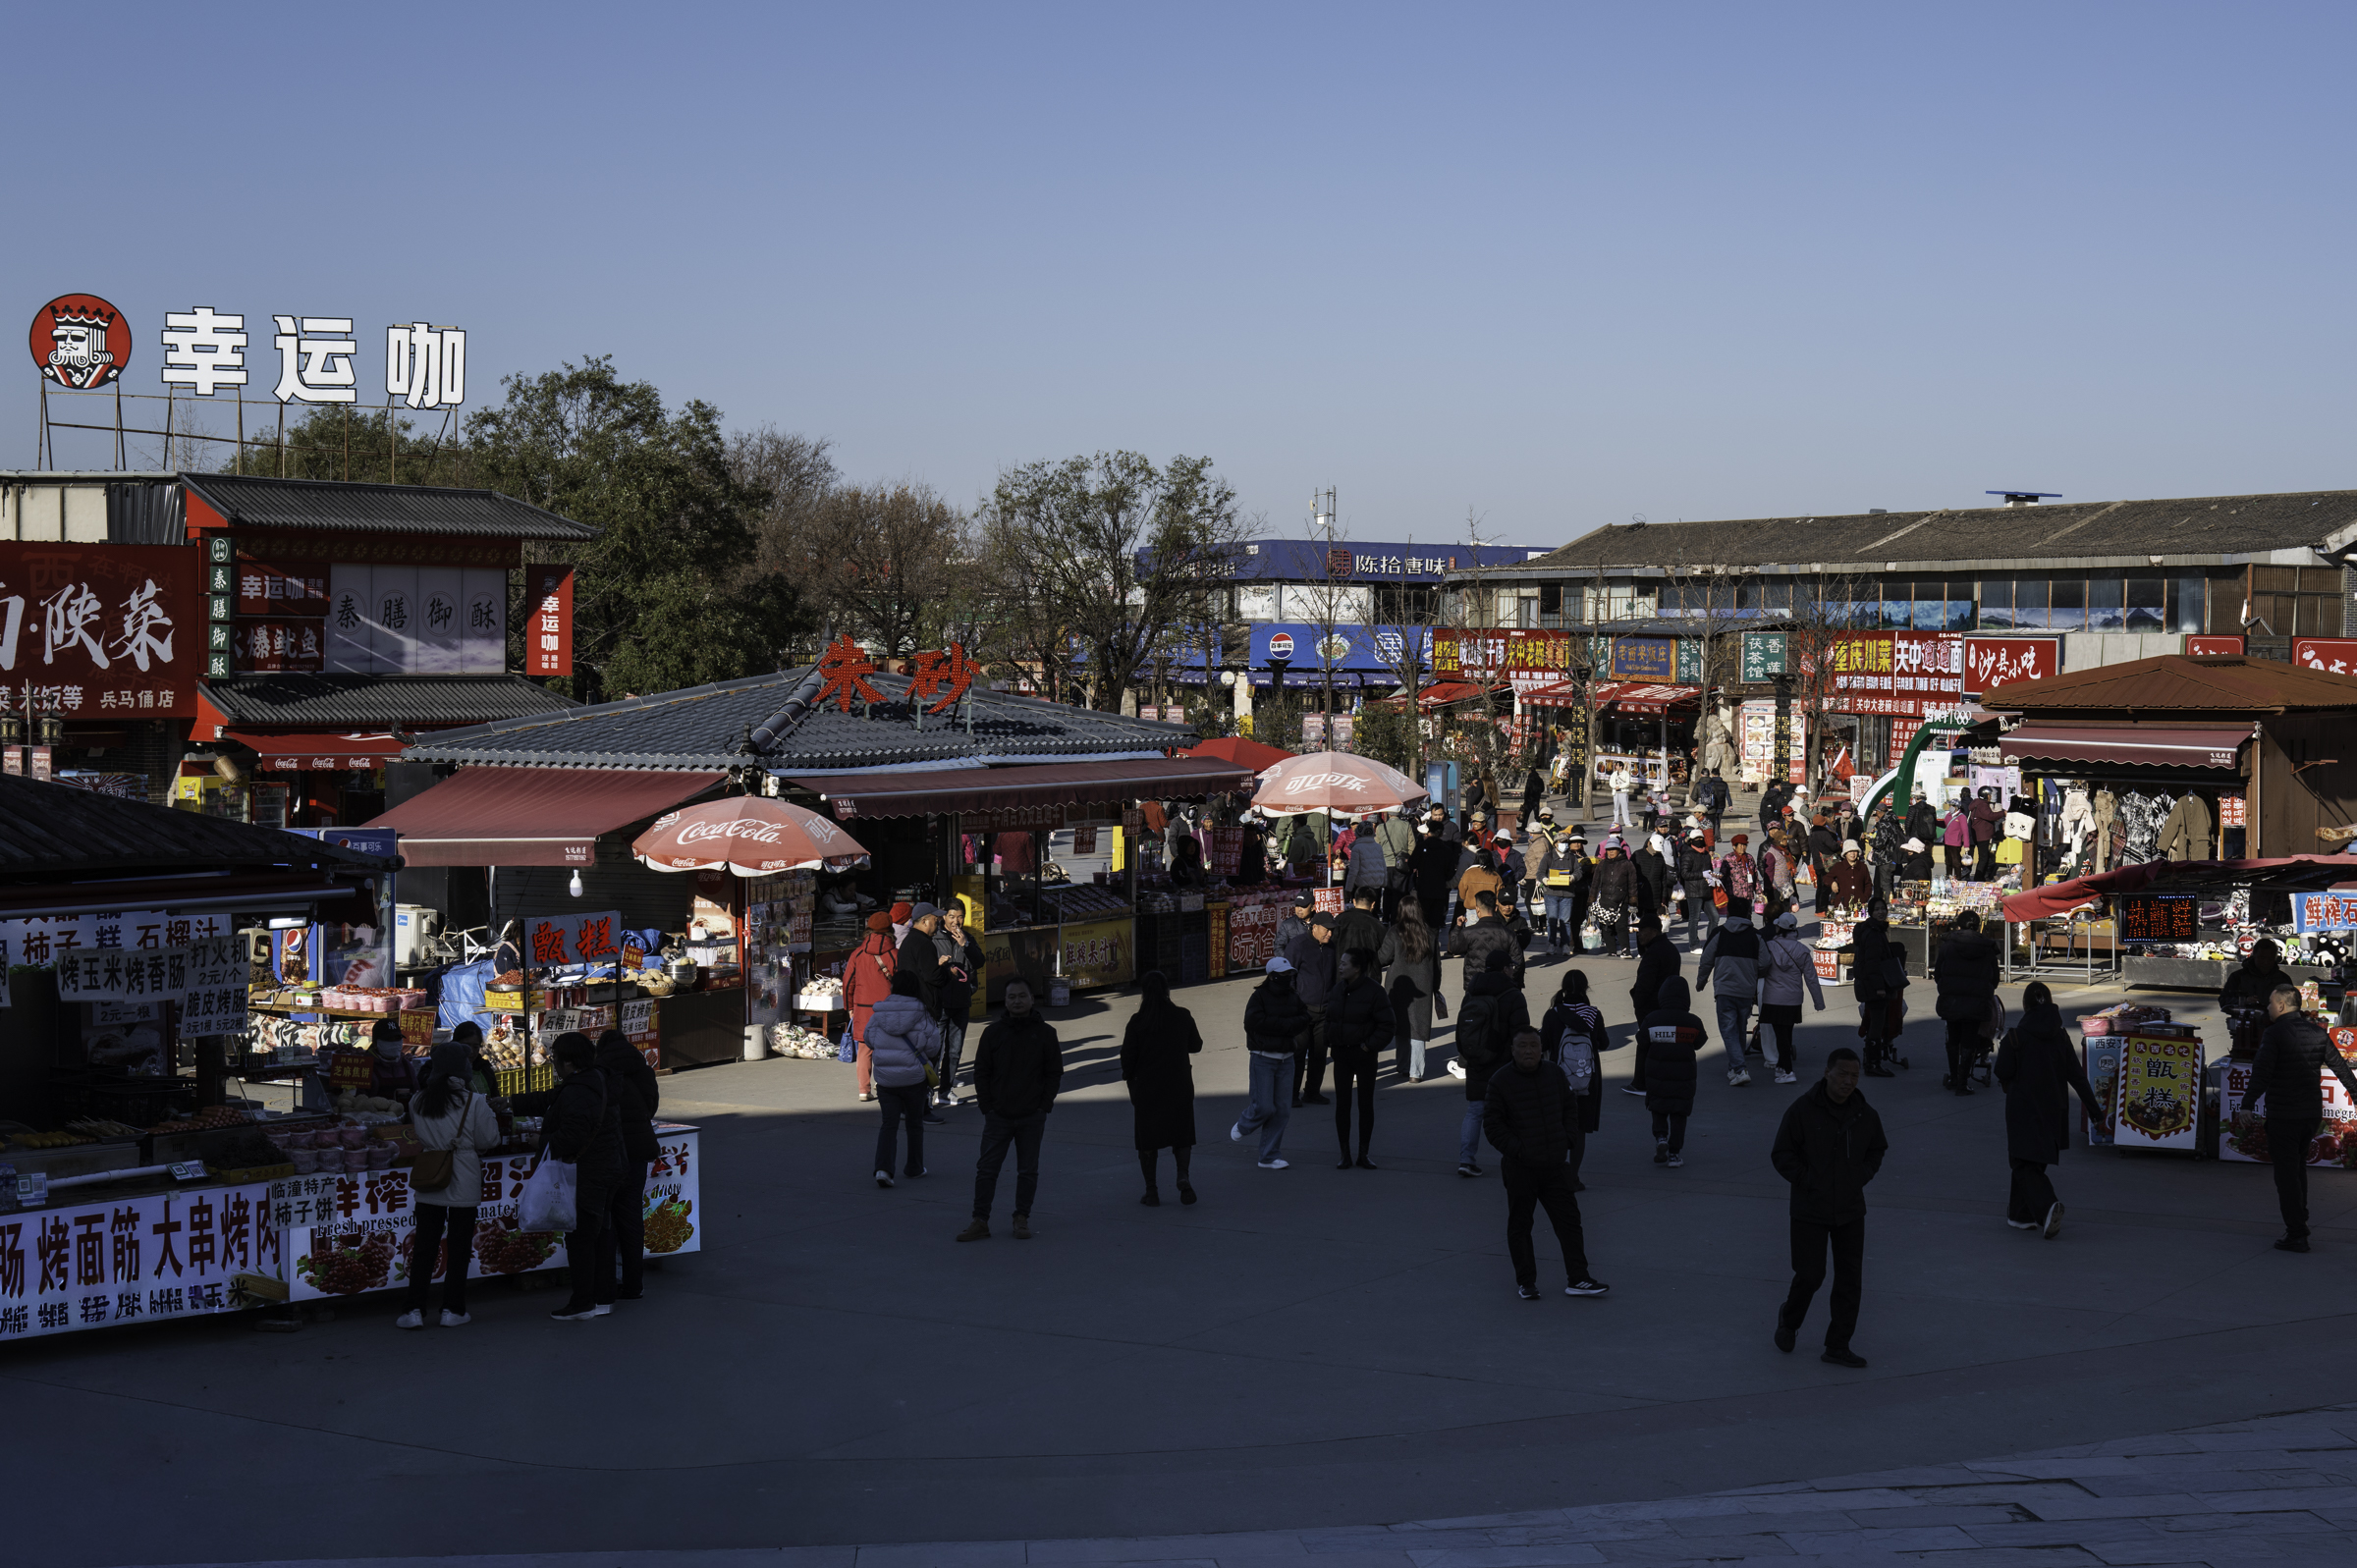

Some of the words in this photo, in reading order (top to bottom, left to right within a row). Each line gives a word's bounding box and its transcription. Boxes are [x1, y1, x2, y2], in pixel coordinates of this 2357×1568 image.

[162, 306, 466, 409] 幸运咖
[1355, 555, 1447, 576] 陈拾唐味
[241, 574, 305, 600] 幸运咖
[307, 578, 324, 588] 现磨
[307, 589, 324, 599] 咖啡
[211, 568, 227, 676] 秦膳御酥
[336, 594, 497, 629] 秦膳御酥
[541, 595, 560, 652] 幸运咖
[1617, 644, 1668, 662] 老西安饭庄
[1746, 637, 1765, 678] 茯茶馆
[1834, 639, 1891, 673] 重庆川菜
[811, 633, 980, 714] 朱砂
[1978, 645, 2042, 687] 沙县小吃
[99, 689, 175, 709] 兵马俑店
[275, 758, 299, 769] Coca-Cola
[312, 757, 335, 769] Coca-Cola
[349, 756, 371, 768] Coca-Cola
[1285, 772, 1372, 795] 可口可乐
[677, 818, 789, 845] Coca-Cola
[1213, 829, 1243, 841] 干柿饼
[352, 841, 383, 851] 百事可乐
[672, 857, 696, 868] Coca-Cola
[761, 860, 787, 869] 可口可乐
[697, 872, 723, 883] 可口可乐
[137, 917, 220, 949] 石榴汁
[531, 916, 620, 964] 甑糕
[23, 930, 82, 964] 柿子
[191, 939, 248, 969] 打火机
[1231, 928, 1276, 964] 6元1盒
[59, 954, 122, 993] 烤玉米
[125, 953, 185, 996] 烤香肠
[198, 967, 242, 986] 2元/个
[100, 1005, 150, 1022] 2元一根
[186, 988, 247, 1017] 脆皮烤肠
[186, 1018, 212, 1034] 3元1根
[216, 1016, 244, 1031] 5元2根
[400, 1013, 434, 1034] 鲜榨石榴汁
[544, 1014, 576, 1031] 石榴汁
[409, 1035, 422, 1044] 10元
[2134, 1042, 2190, 1057] 陕西名吃
[333, 1065, 370, 1079] 芝麻焦饼
[2128, 1055, 2143, 1098] 软糯香甜
[2143, 1057, 2178, 1109] 甑糕
[271, 1176, 336, 1200] 临潼特产
[274, 1196, 334, 1227] 柿子饼
[360, 1210, 417, 1235] pressed
[37, 1206, 140, 1296] 烤面筋
[152, 1187, 281, 1279] 大串烤肉
